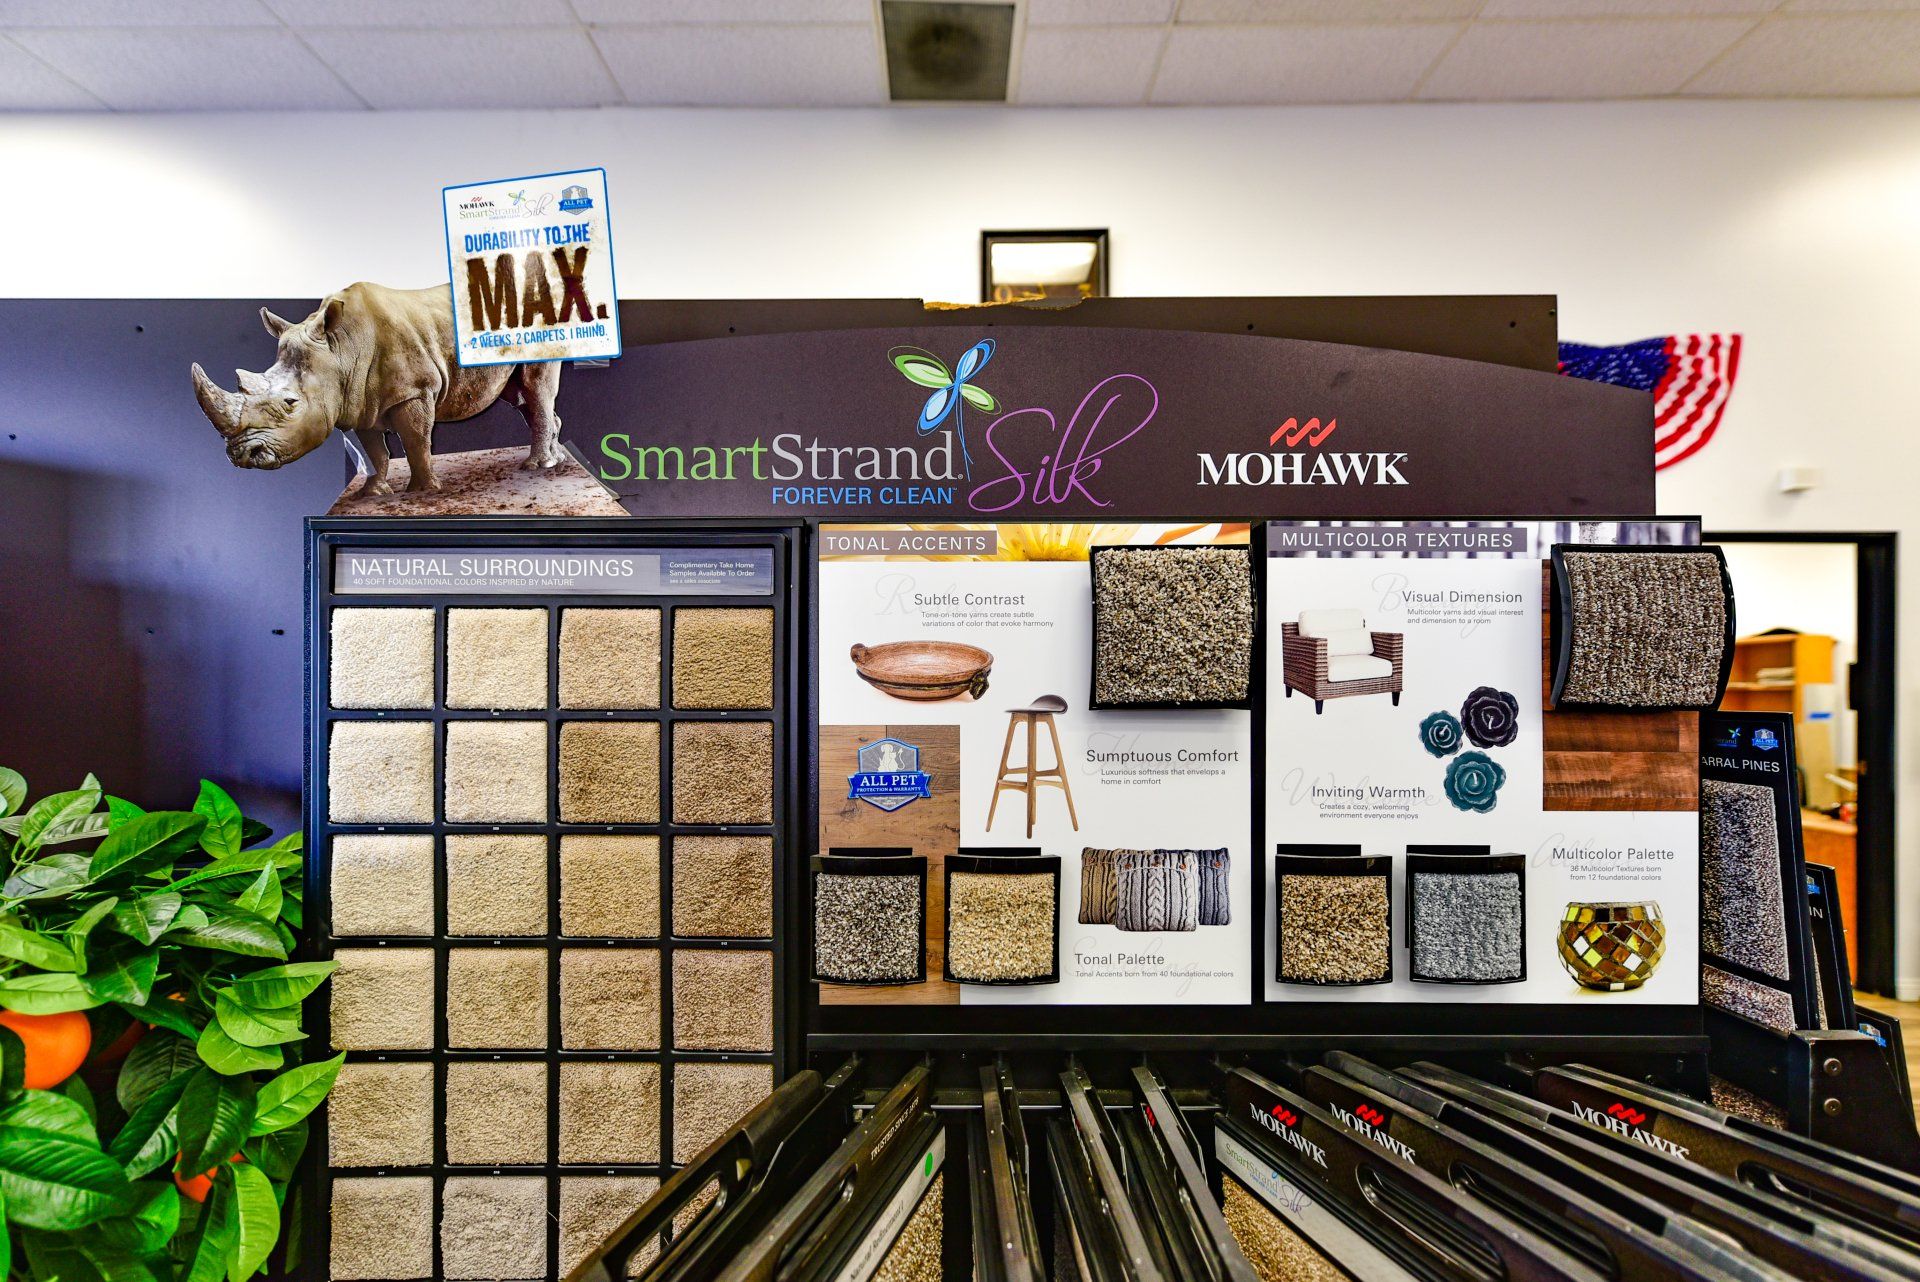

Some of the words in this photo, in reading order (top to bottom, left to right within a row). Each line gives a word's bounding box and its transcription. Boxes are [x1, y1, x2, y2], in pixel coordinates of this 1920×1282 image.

[459, 201, 494, 210] MOHAWK
[522, 193, 555, 218] Silk
[576, 198, 588, 206] PET
[465, 229, 539, 253] DURABILITY
[543, 225, 562, 245] TO
[562, 221, 590, 243] THE
[467, 247, 609, 332] MAX.
[471, 336, 478, 349] 2
[479, 332, 514, 347] WEEKS.
[516, 333, 523, 345] 2
[524, 329, 568, 345] CARPETS.
[576, 322, 607, 338] RHINO.
[599, 431, 956, 482] SmartStrand
[969, 374, 1159, 512] Silk
[1196, 452, 1410, 486] MOHAWK
[772, 487, 873, 506] FOREVER
[879, 487, 954, 505] CLEAN
[827, 536, 890, 551] TONAL
[898, 536, 987, 551] ACCENTS
[1282, 532, 1408, 547] MULTICOLOR
[1415, 532, 1514, 548] TEXTURES
[351, 559, 453, 576] NATURAL
[460, 559, 634, 577] SURROUNDINGS
[365, 578, 387, 586] SOFT
[388, 578, 452, 586] FOUNDATIONAL
[454, 578, 487, 586] COLORS
[489, 578, 527, 586] INSPIRED
[528, 578, 539, 586] BY
[541, 578, 575, 586] NATURE
[914, 593, 960, 606] Subtle
[964, 593, 1026, 606] Contrast
[1401, 590, 1444, 603] Visual
[1449, 591, 1523, 603] Dimension
[1407, 608, 1441, 616] Multicolor
[1023, 620, 1054, 628] harmony
[1086, 749, 1172, 765] Sumptuous
[1177, 749, 1239, 762] Comfort
[1101, 768, 1136, 776] Luxurious
[1138, 768, 1169, 776] softness
[1170, 768, 1185, 776] that
[1186, 768, 1220, 777] envelops
[1742, 759, 1780, 773] PINES
[860, 775, 888, 787] ALL
[891, 774, 918, 786] PET
[1312, 785, 1364, 800] Inviting
[1369, 786, 1425, 798] Warmth
[1372, 803, 1410, 811] welcoming
[1552, 847, 1623, 860] Multicolor
[1627, 848, 1674, 860] Palette
[1074, 953, 1112, 965] Tonal
[1117, 953, 1165, 965] Palette
[1076, 970, 1094, 978] Tonal
[1096, 970, 1123, 978] Accents
[1169, 970, 1212, 978] foundational
[1250, 1102, 1329, 1169] MOHAWK
[1329, 1101, 1416, 1165] MOHAWK
[1571, 1100, 1690, 1161] MOHAWK
[1225, 1143, 1279, 1192] SmartStrand
[1279, 1182, 1313, 1221] Silk
